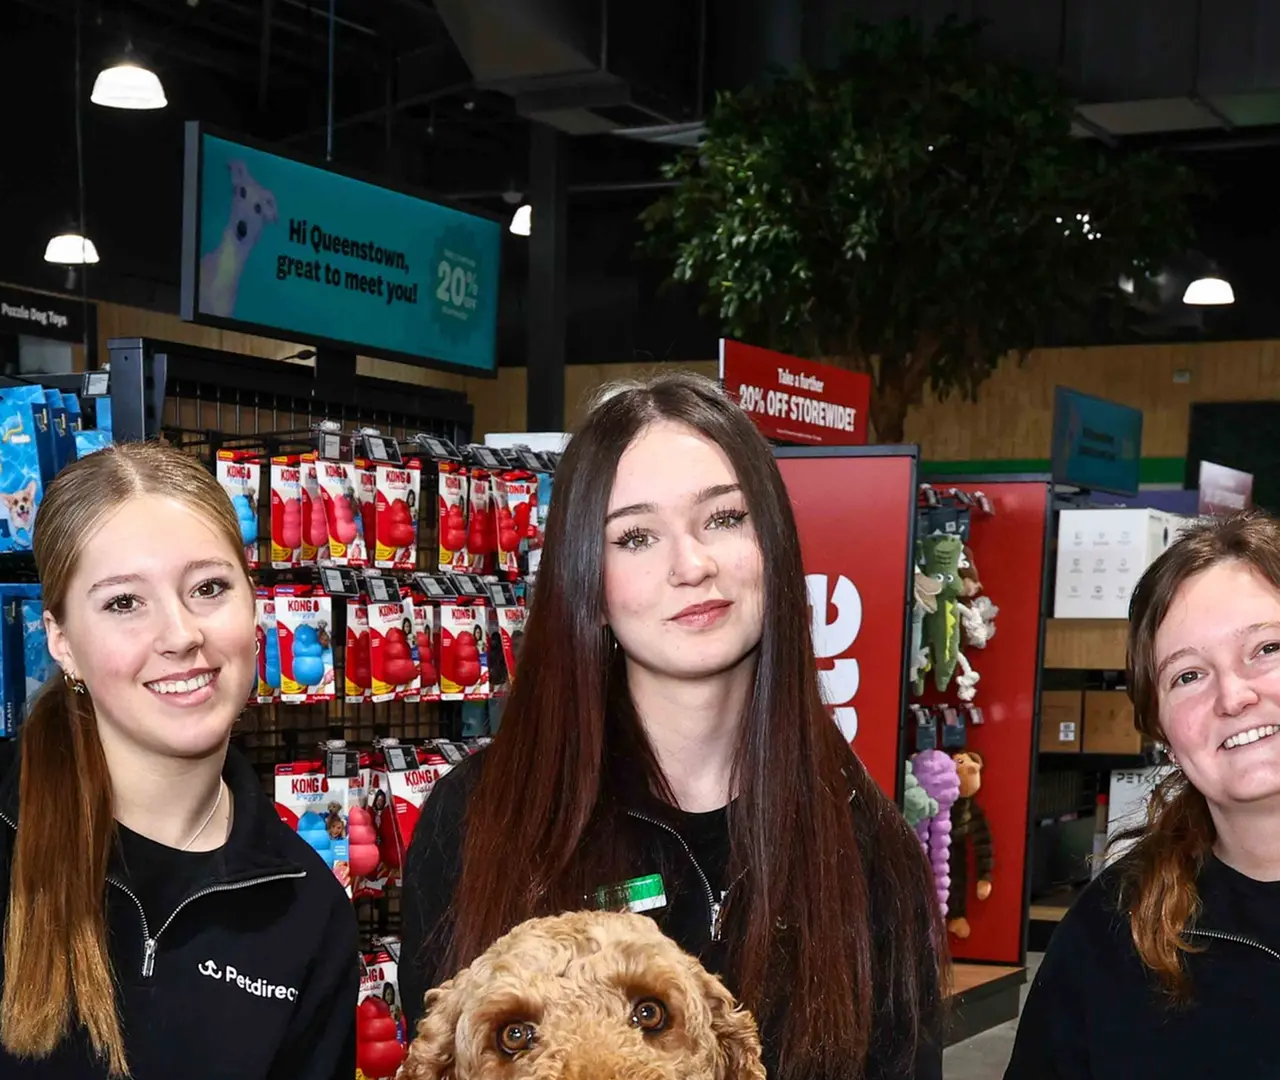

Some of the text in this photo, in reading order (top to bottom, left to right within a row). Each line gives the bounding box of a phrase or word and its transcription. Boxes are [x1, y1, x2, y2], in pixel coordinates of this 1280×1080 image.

[289, 218, 307, 244] Hi
[310, 225, 410, 275] Queenstown,
[276, 254, 418, 305] great to meet you!
[1, 302, 67, 327] Puzzle Dog Toys
[777, 368, 794, 387] Take
[799, 371, 825, 393] further
[739, 384, 857, 432] 20% OFF STOREWIDE!
[226, 466, 245, 479] KONG
[325, 465, 343, 478] KONG
[386, 471, 406, 484] KONG
[288, 600, 312, 613] KONG
[292, 778, 319, 794] KONG
[404, 770, 433, 787] KONG
